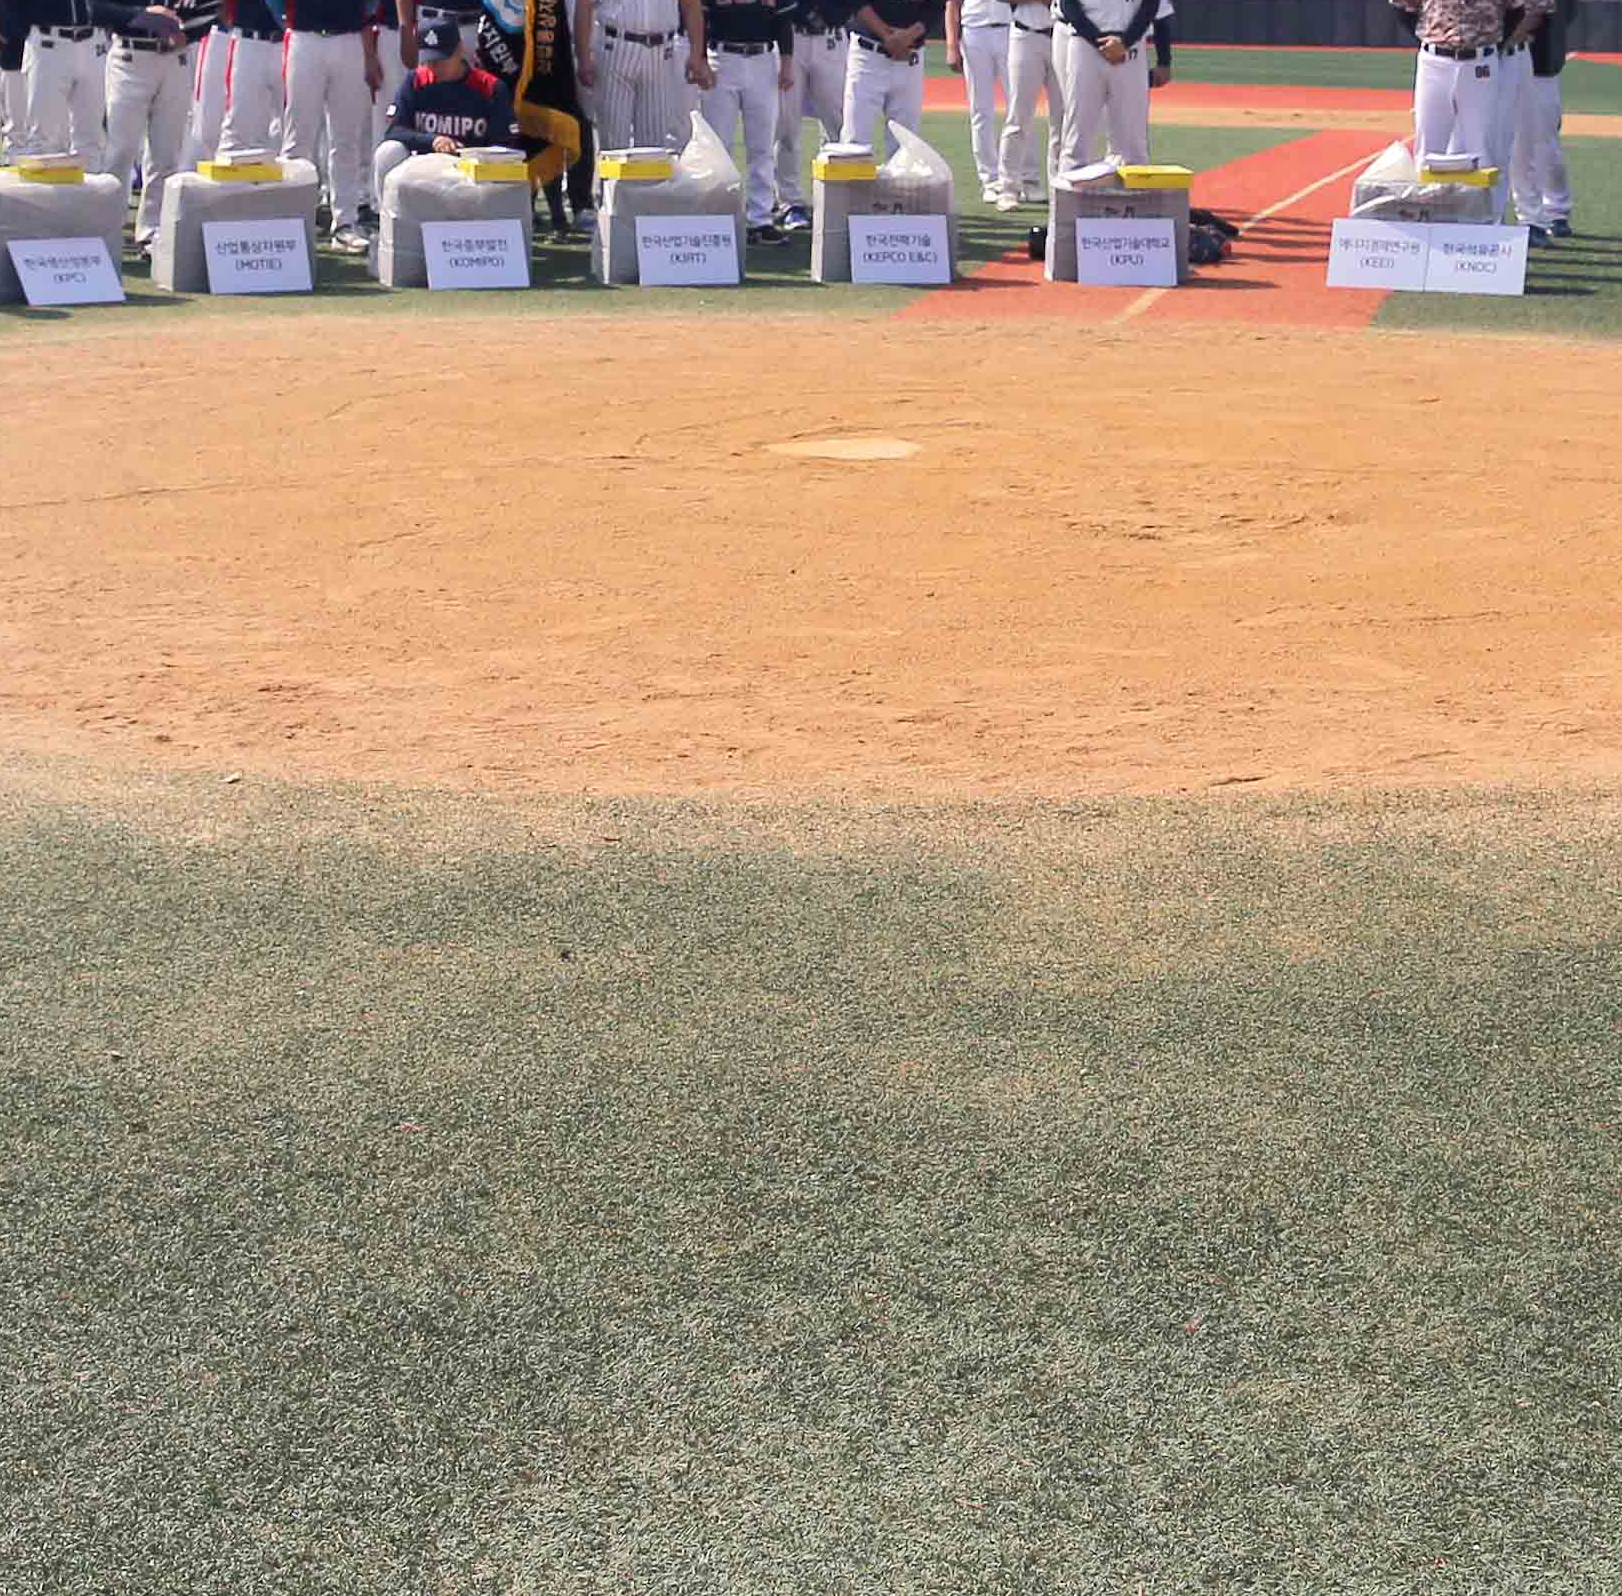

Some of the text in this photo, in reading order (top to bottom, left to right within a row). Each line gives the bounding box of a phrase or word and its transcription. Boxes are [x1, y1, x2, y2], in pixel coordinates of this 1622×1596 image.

[414, 111, 488, 138] KOMIPO
[235, 258, 283, 272] (MOTIE)
[449, 255, 505, 269] (KOMIPO)
[863, 251, 907, 265] (KEPCO
[1110, 254, 1144, 266] (KPU)
